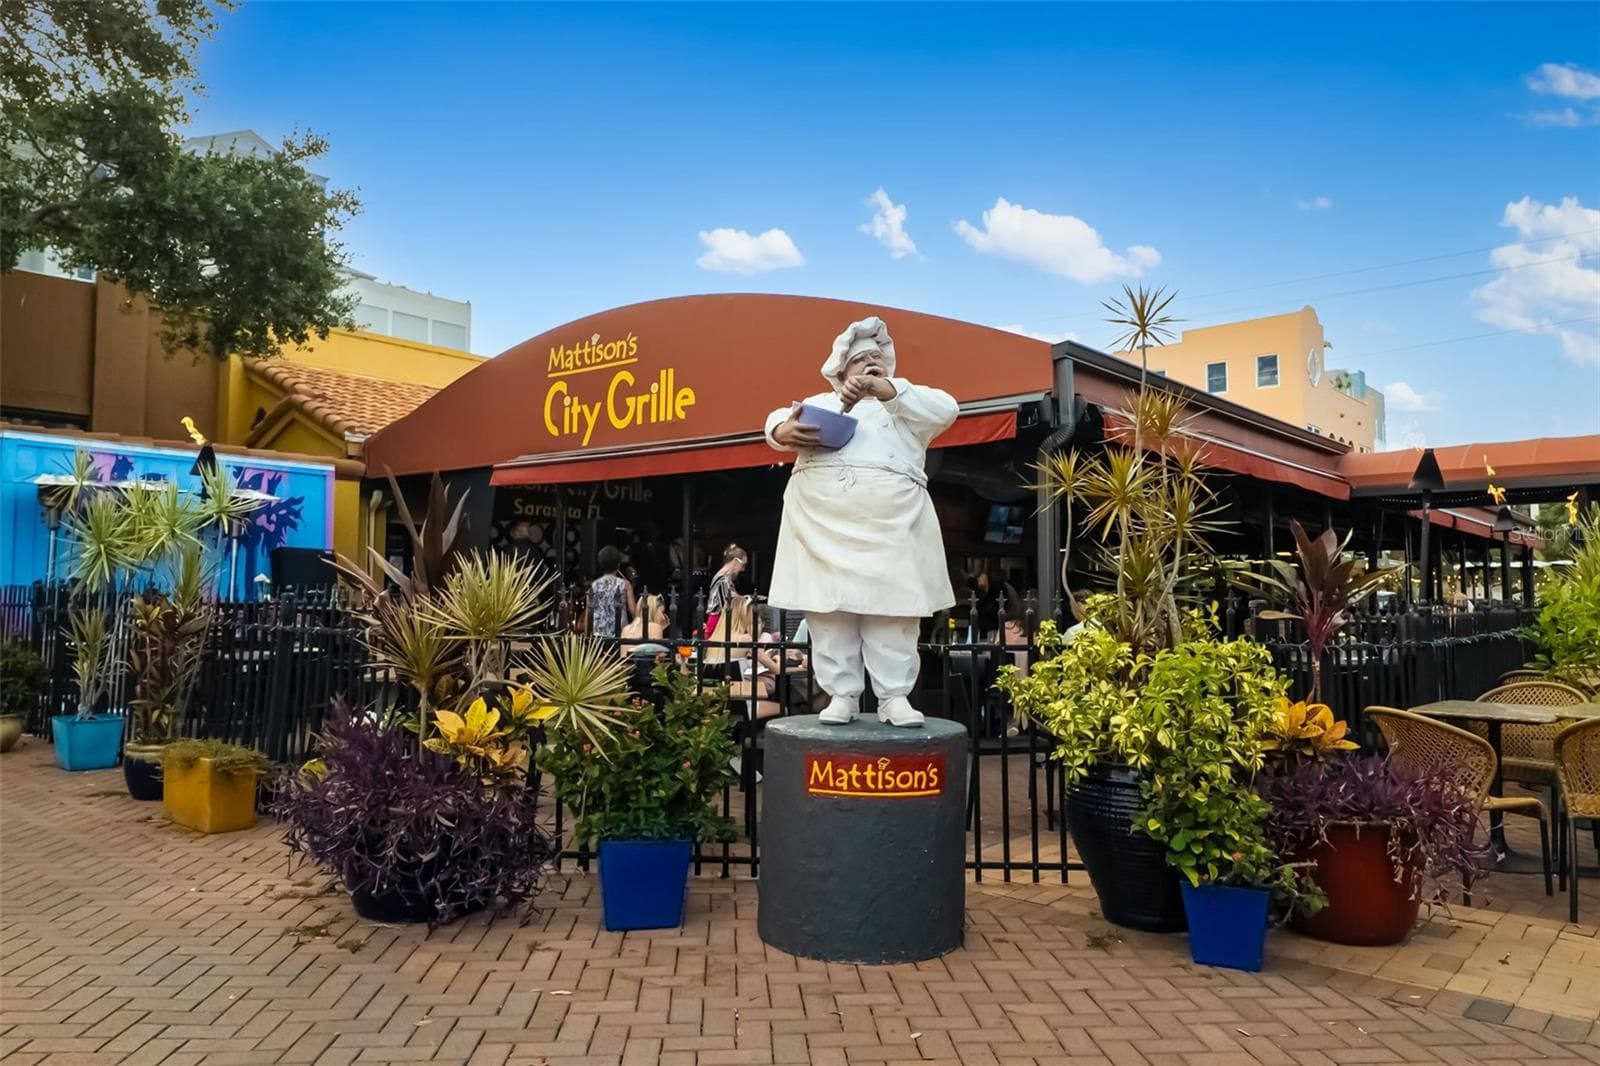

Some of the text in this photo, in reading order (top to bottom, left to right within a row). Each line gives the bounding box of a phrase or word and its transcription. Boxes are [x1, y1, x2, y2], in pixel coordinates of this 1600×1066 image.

[547, 332, 638, 371] Mattison's
[544, 367, 696, 447] City Grille
[513, 498, 604, 520] Sarasta FL
[808, 757, 938, 791] Mattison's
